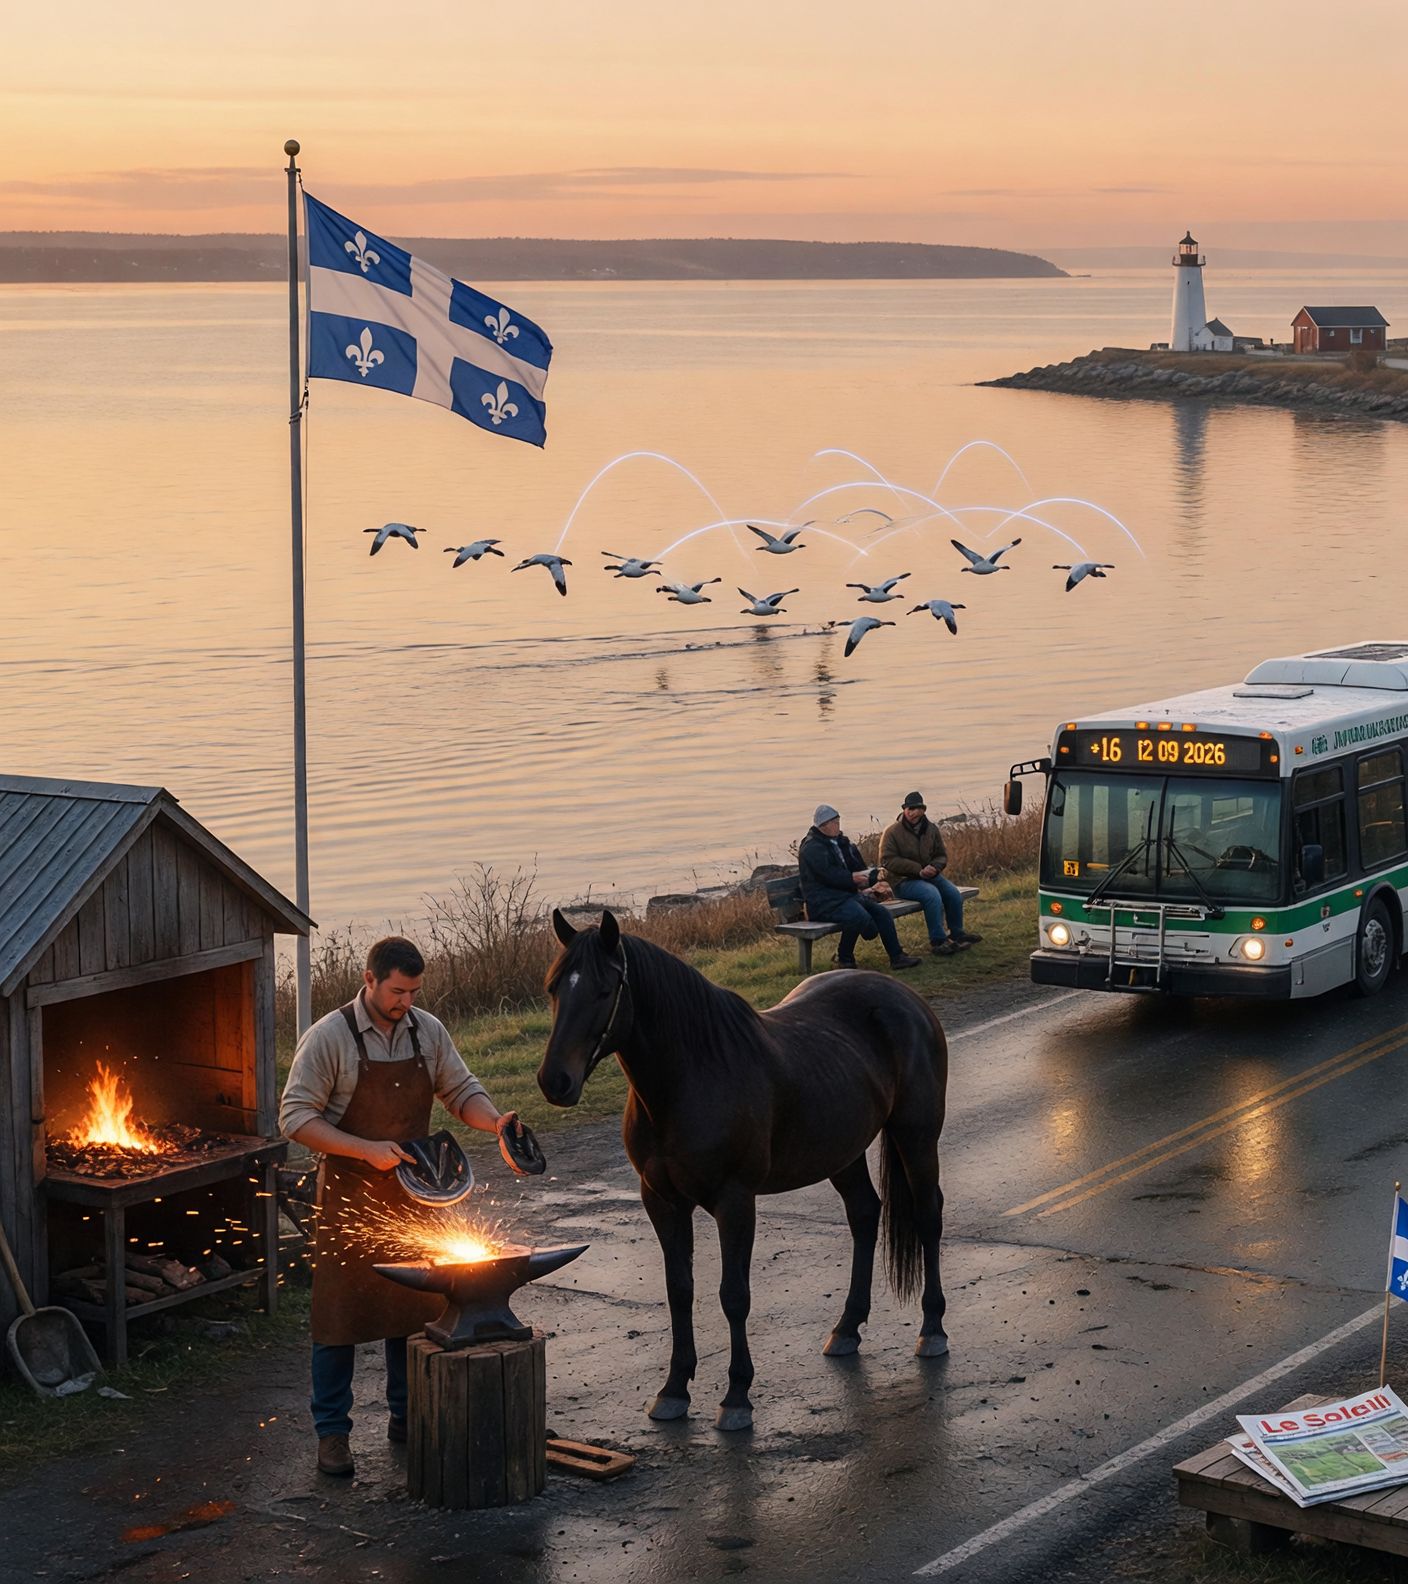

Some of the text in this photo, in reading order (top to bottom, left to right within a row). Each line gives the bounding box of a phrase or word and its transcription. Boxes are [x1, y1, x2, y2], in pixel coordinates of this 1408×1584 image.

[1158, 740, 1179, 762] 09
[1184, 742, 1226, 764] 2026
[1260, 1420, 1299, 1433] Le
